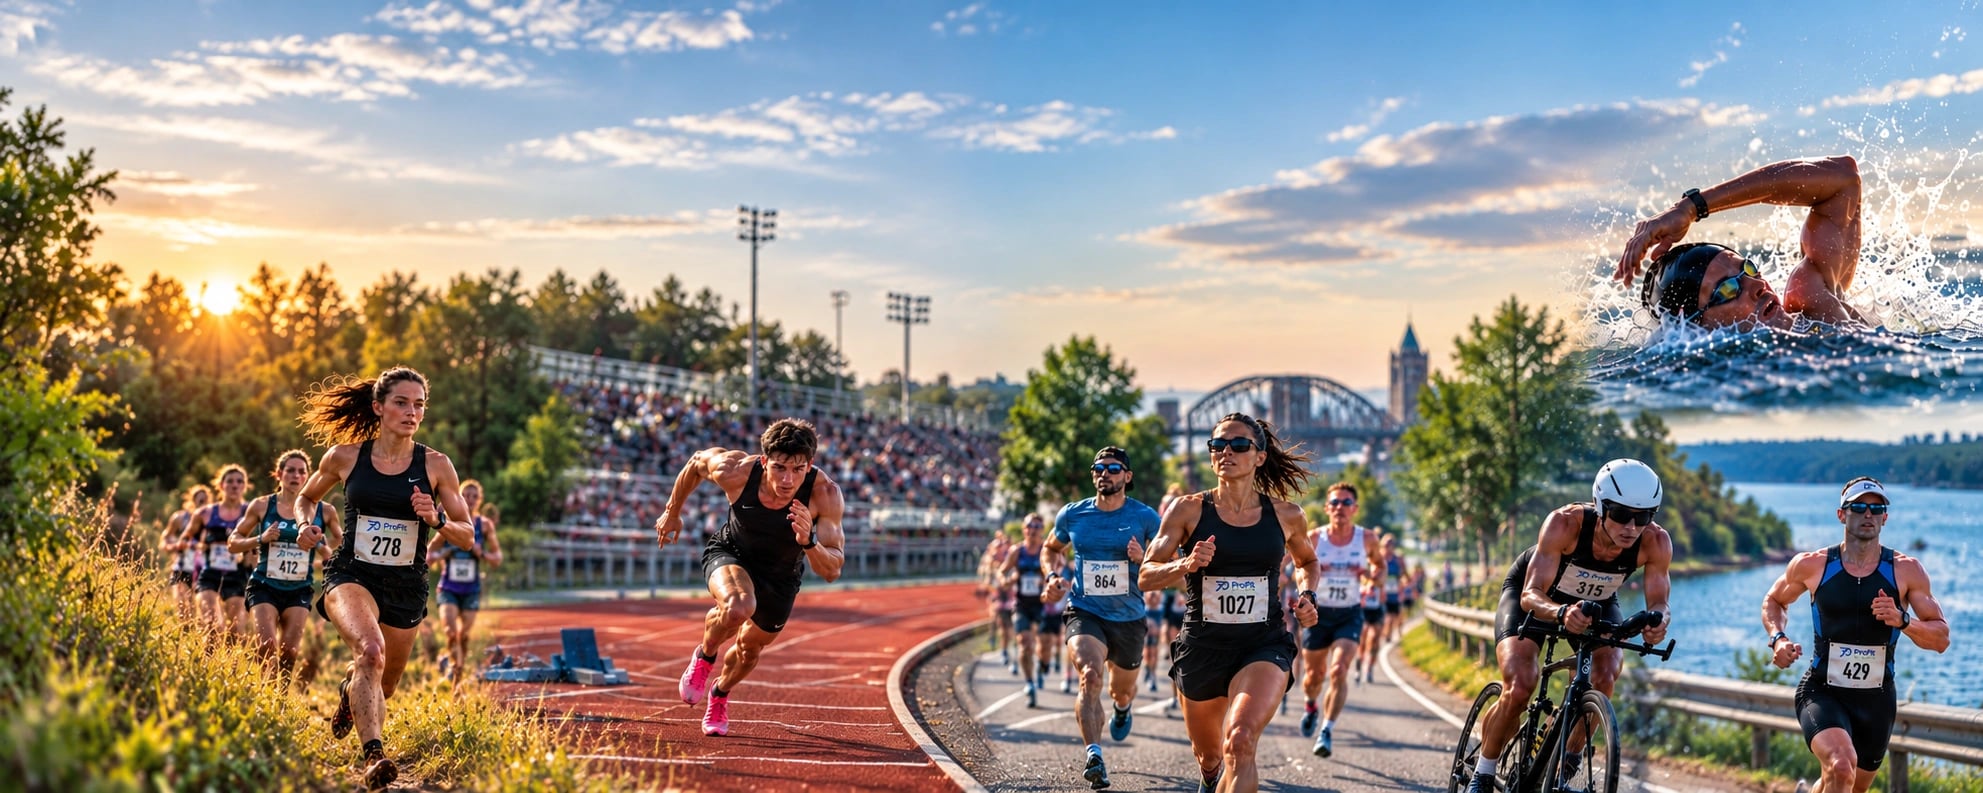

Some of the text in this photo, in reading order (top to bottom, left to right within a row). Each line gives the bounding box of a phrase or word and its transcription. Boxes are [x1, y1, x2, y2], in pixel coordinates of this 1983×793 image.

[371, 535, 402, 557] 278
[279, 560, 298, 575] 412
[1094, 574, 1117, 589] 864
[1575, 581, 1605, 597] 315
[1217, 595, 1256, 615] 1027
[1842, 662, 1871, 680] 429
